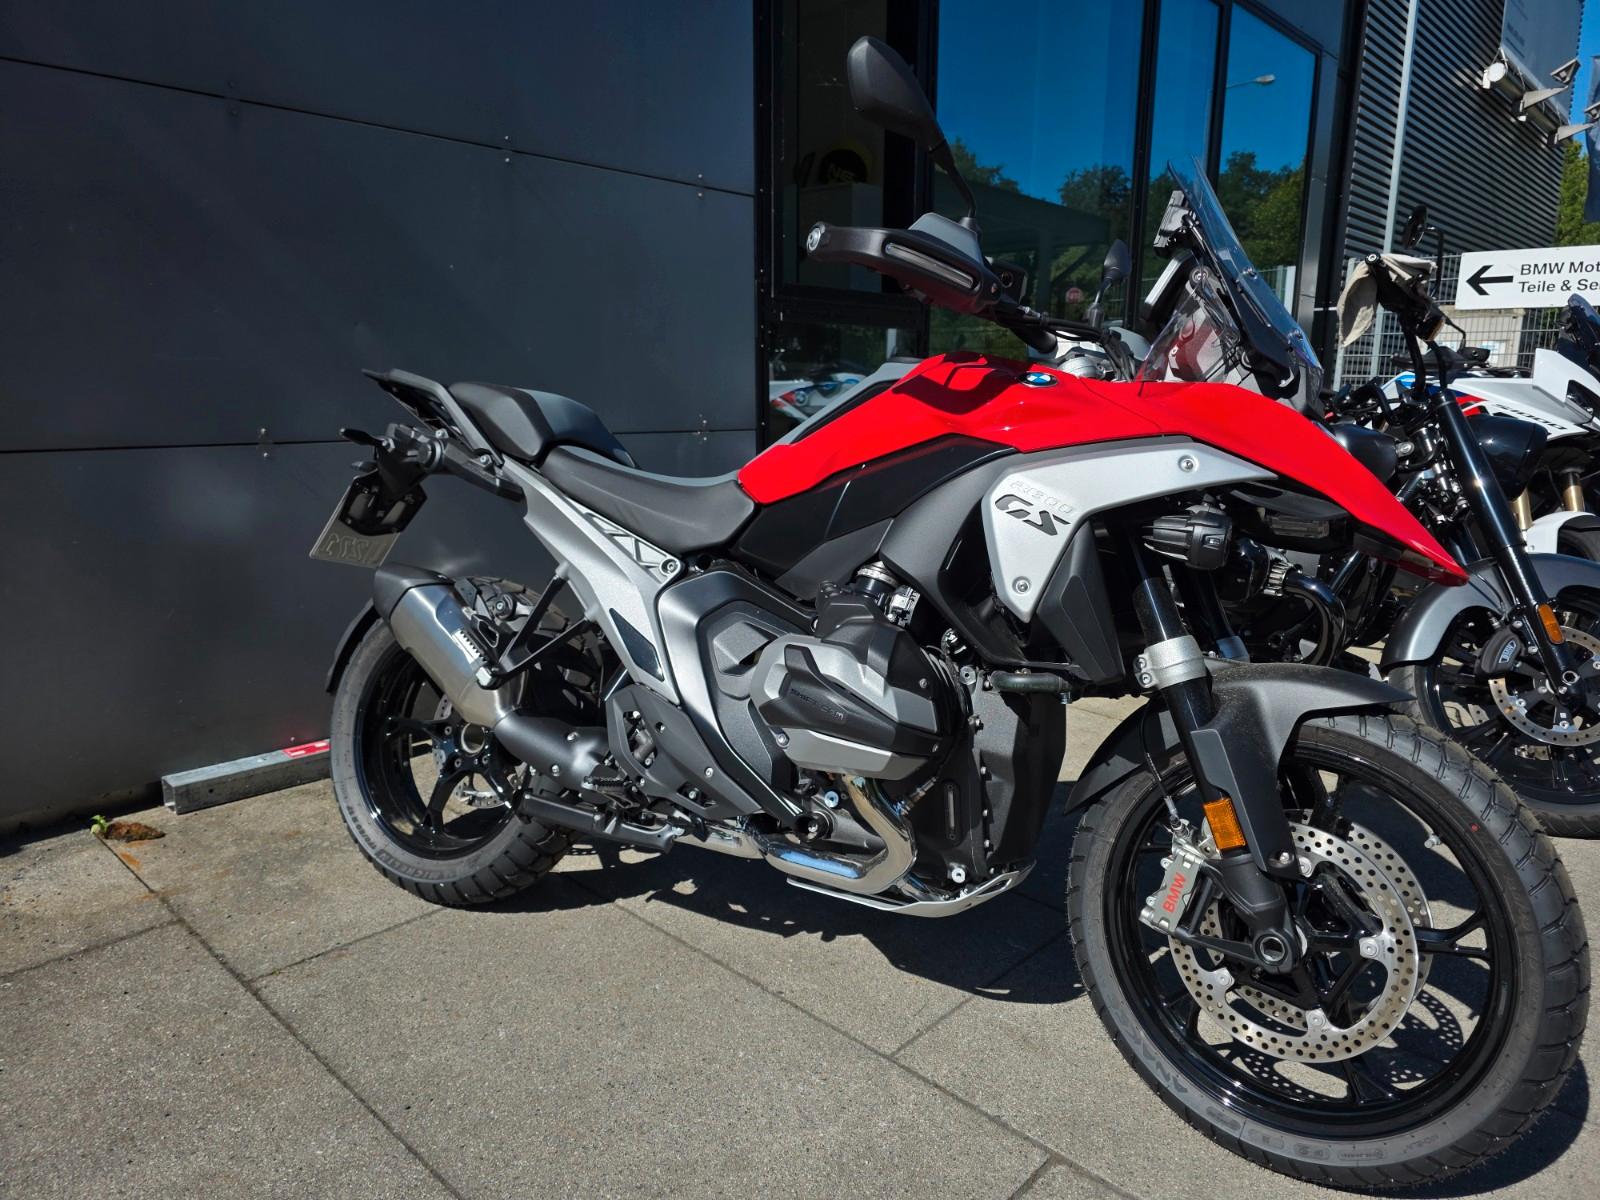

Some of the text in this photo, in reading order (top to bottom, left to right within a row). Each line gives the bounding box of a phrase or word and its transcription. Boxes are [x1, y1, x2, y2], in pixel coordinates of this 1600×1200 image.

[1520, 261, 1565, 276] BMW
[1518, 278, 1600, 293] Teile & Se
[994, 493, 1072, 536] GS
[1162, 871, 1187, 914] BMW
